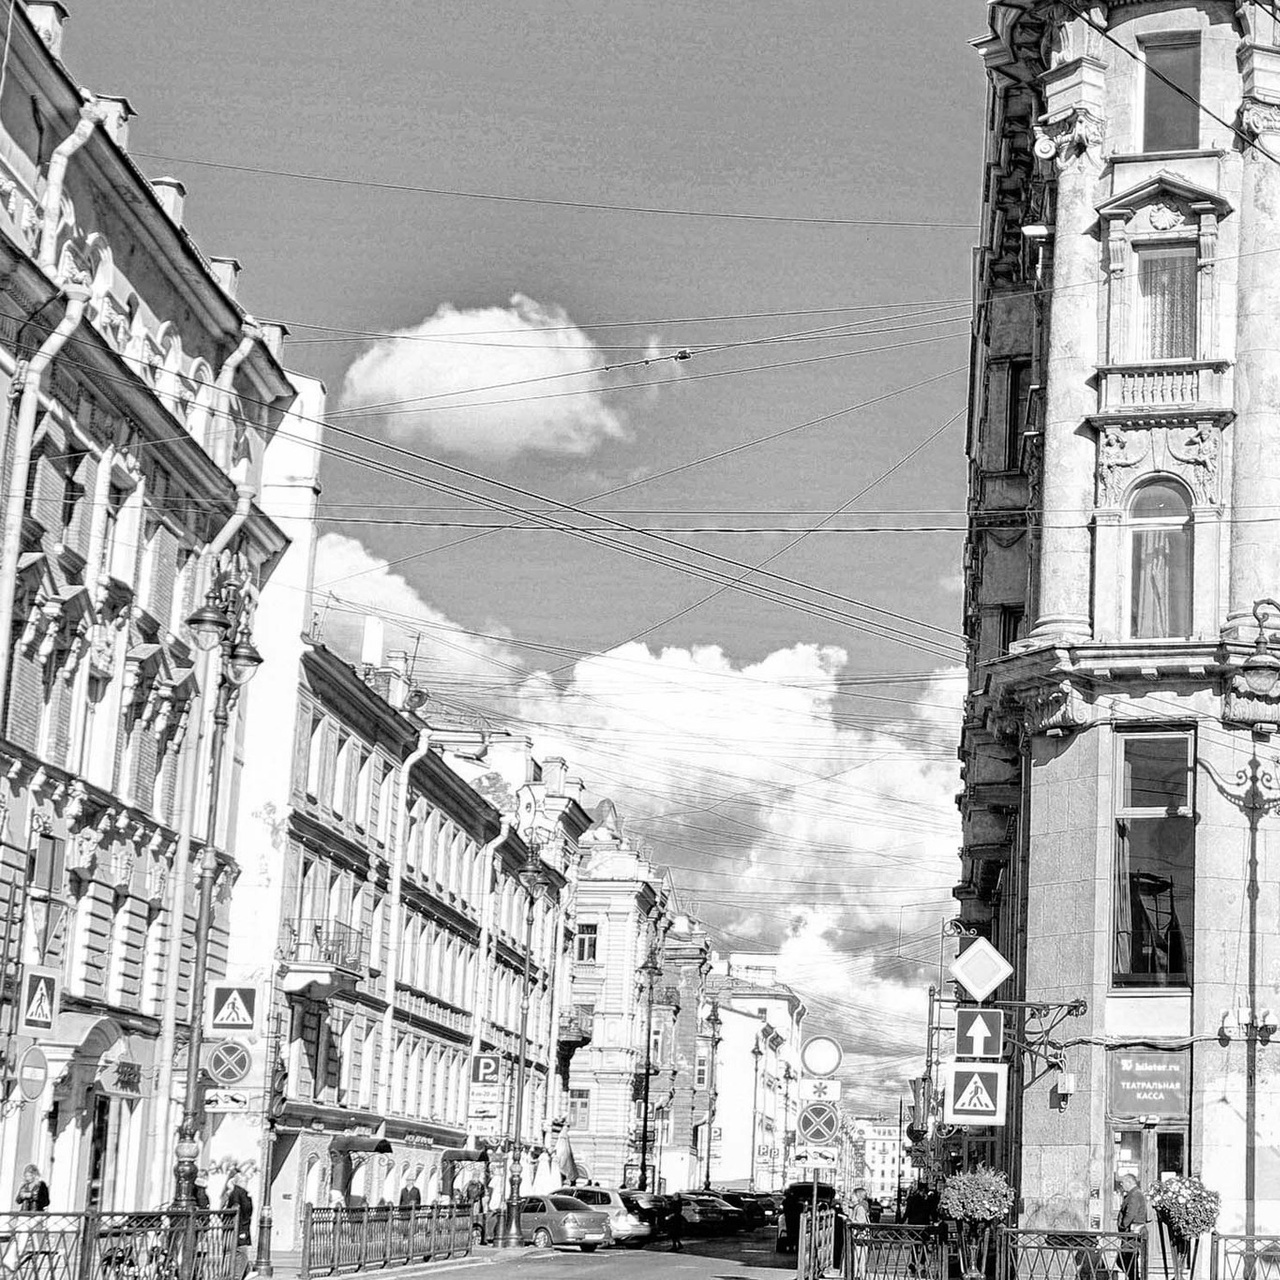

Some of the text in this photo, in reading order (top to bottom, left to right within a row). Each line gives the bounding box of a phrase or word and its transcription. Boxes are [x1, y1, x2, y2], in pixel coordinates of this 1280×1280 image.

[478, 1058, 496, 1081] P
[1121, 1081, 1181, 1090] ТЕАТРАЛЬНАЯ
[1136, 1091, 1165, 1100] КАССА
